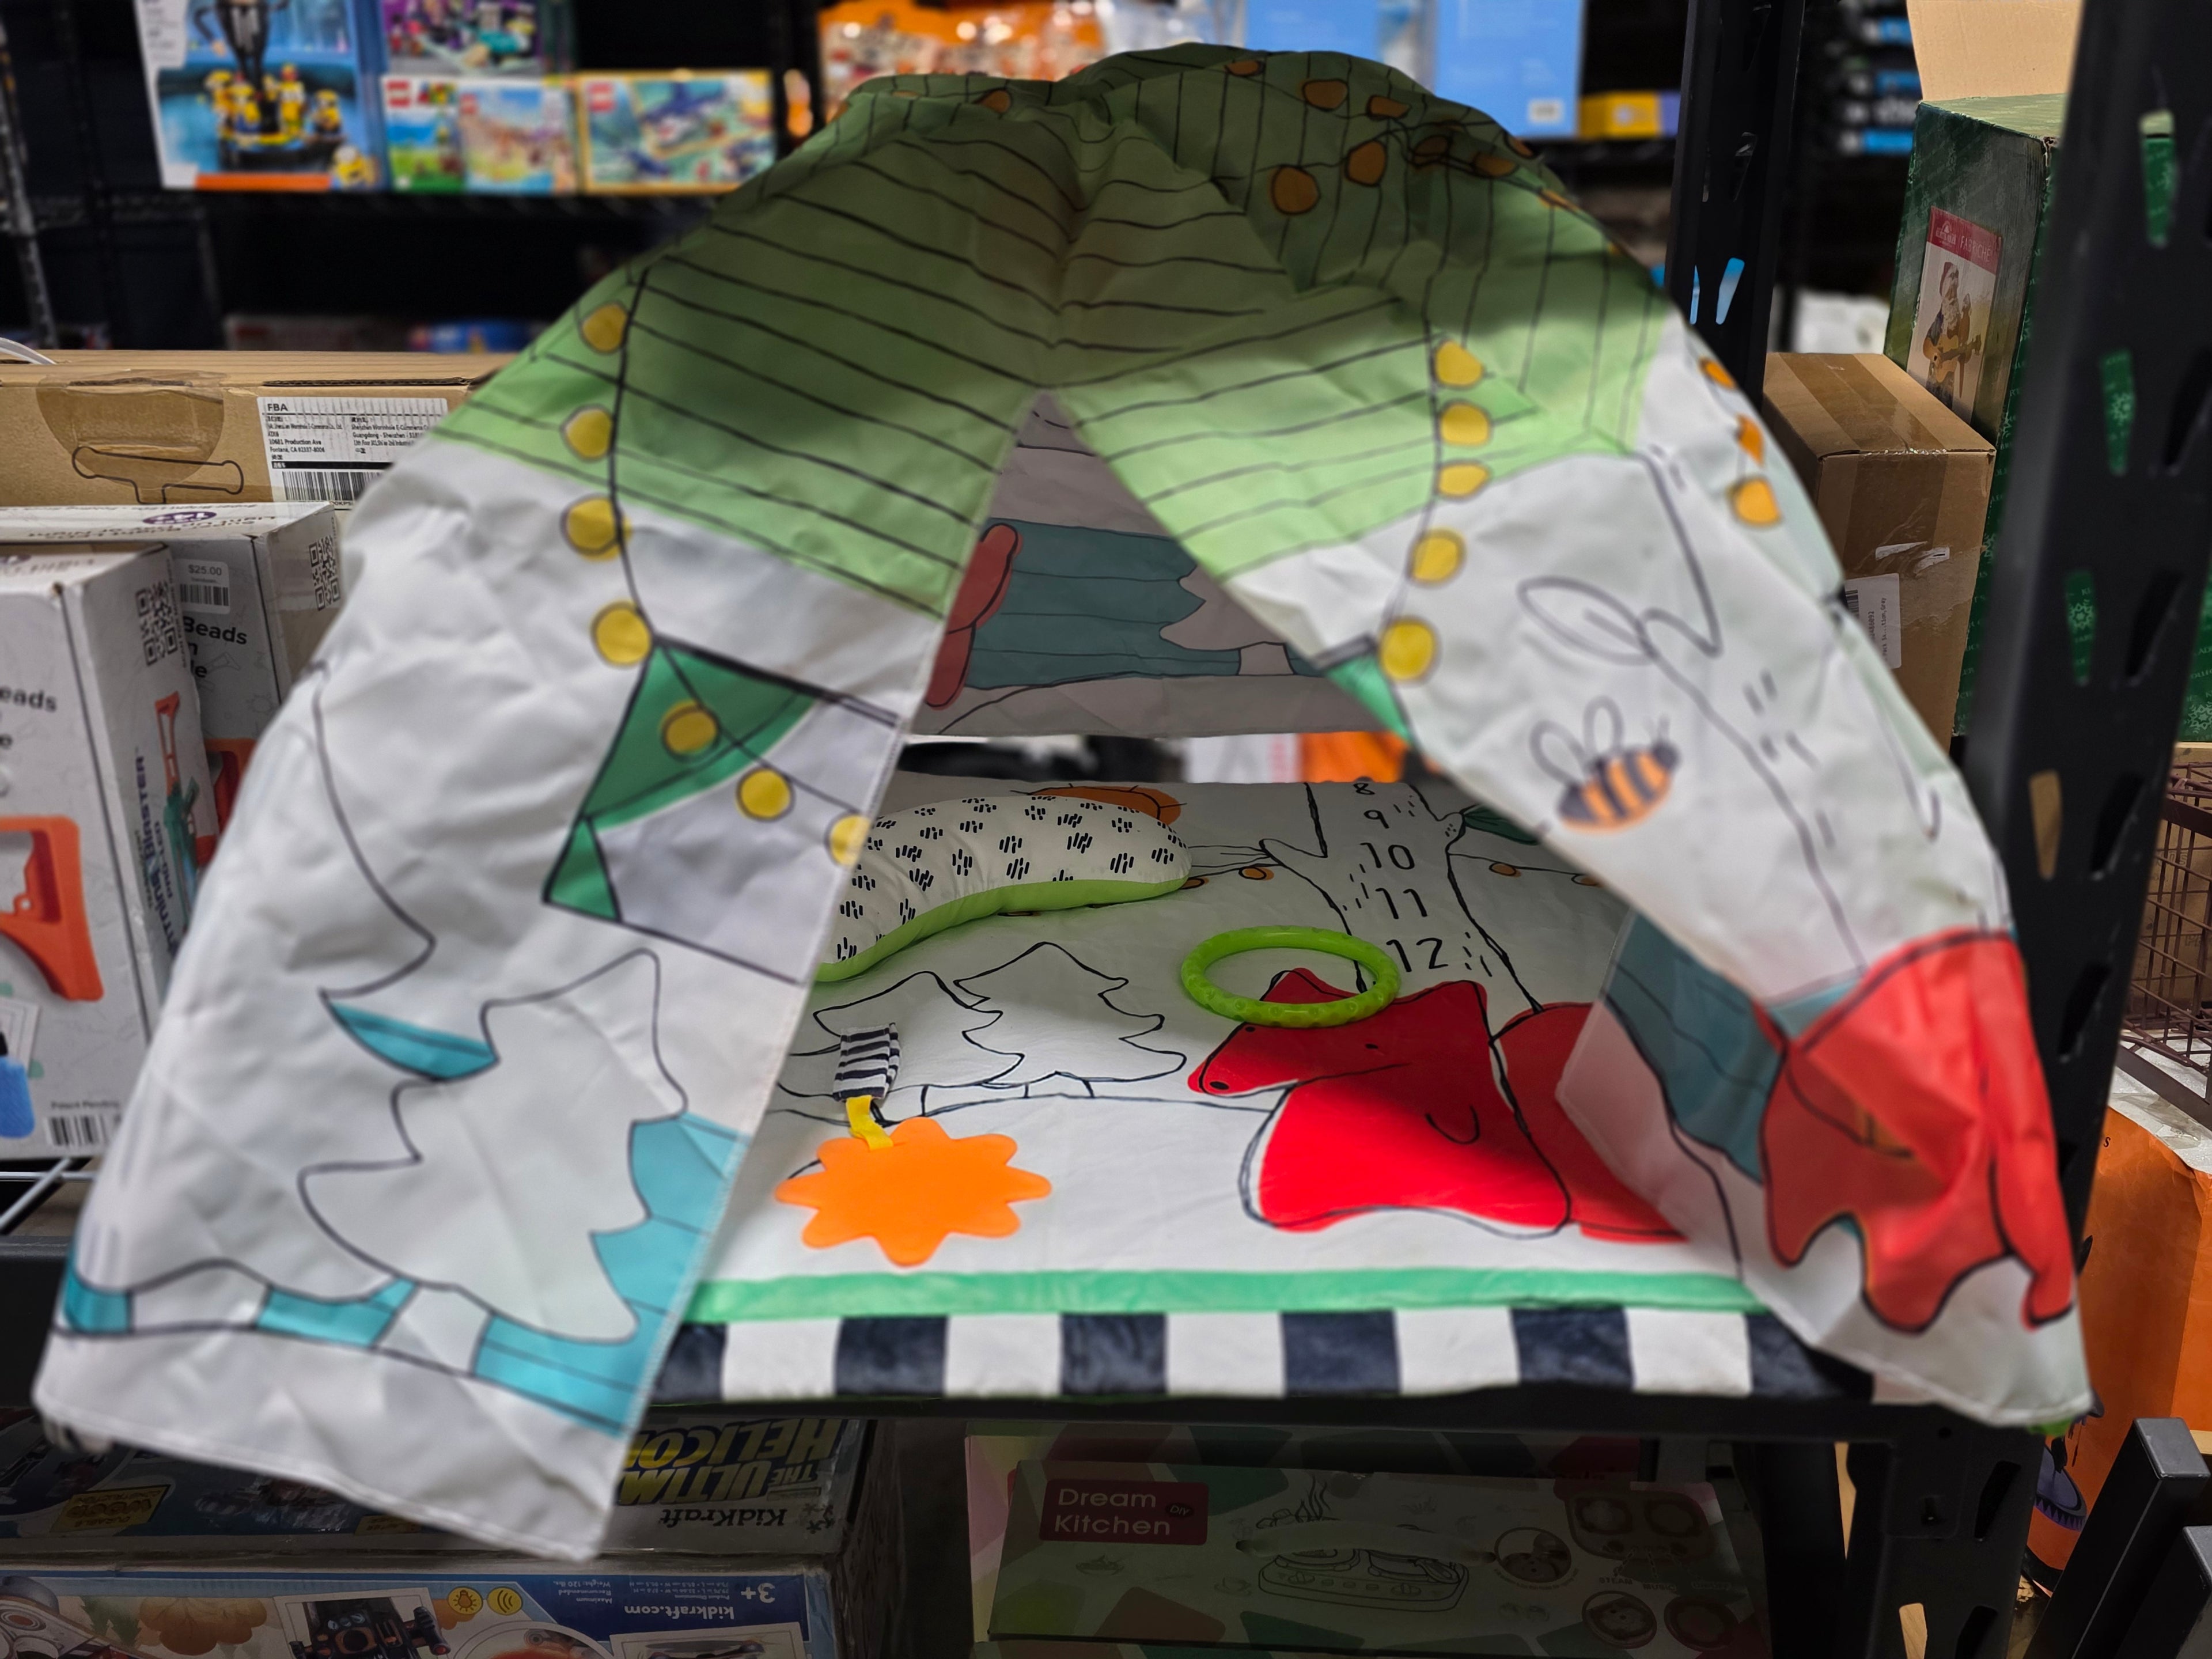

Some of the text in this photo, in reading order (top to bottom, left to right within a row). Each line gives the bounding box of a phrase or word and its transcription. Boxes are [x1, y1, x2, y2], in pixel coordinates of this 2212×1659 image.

[267, 403, 288, 411] FBA
[188, 564, 222, 576] $25.00
[1353, 782, 1376, 796] 8
[1363, 809, 1389, 830] 9
[1359, 842, 1415, 870] 10
[1374, 887, 1428, 919] 11
[1385, 937, 1448, 973] 12
[769, 1464, 815, 1487] THE
[1058, 1488, 1157, 1509] Dream
[660, 1508, 787, 1528] KidKraft
[1169, 1503, 1191, 1517] DIY
[1054, 1514, 1171, 1536] Kitchen
[741, 1582, 776, 1604] 3+
[624, 1605, 734, 1620] kidkraft.com
